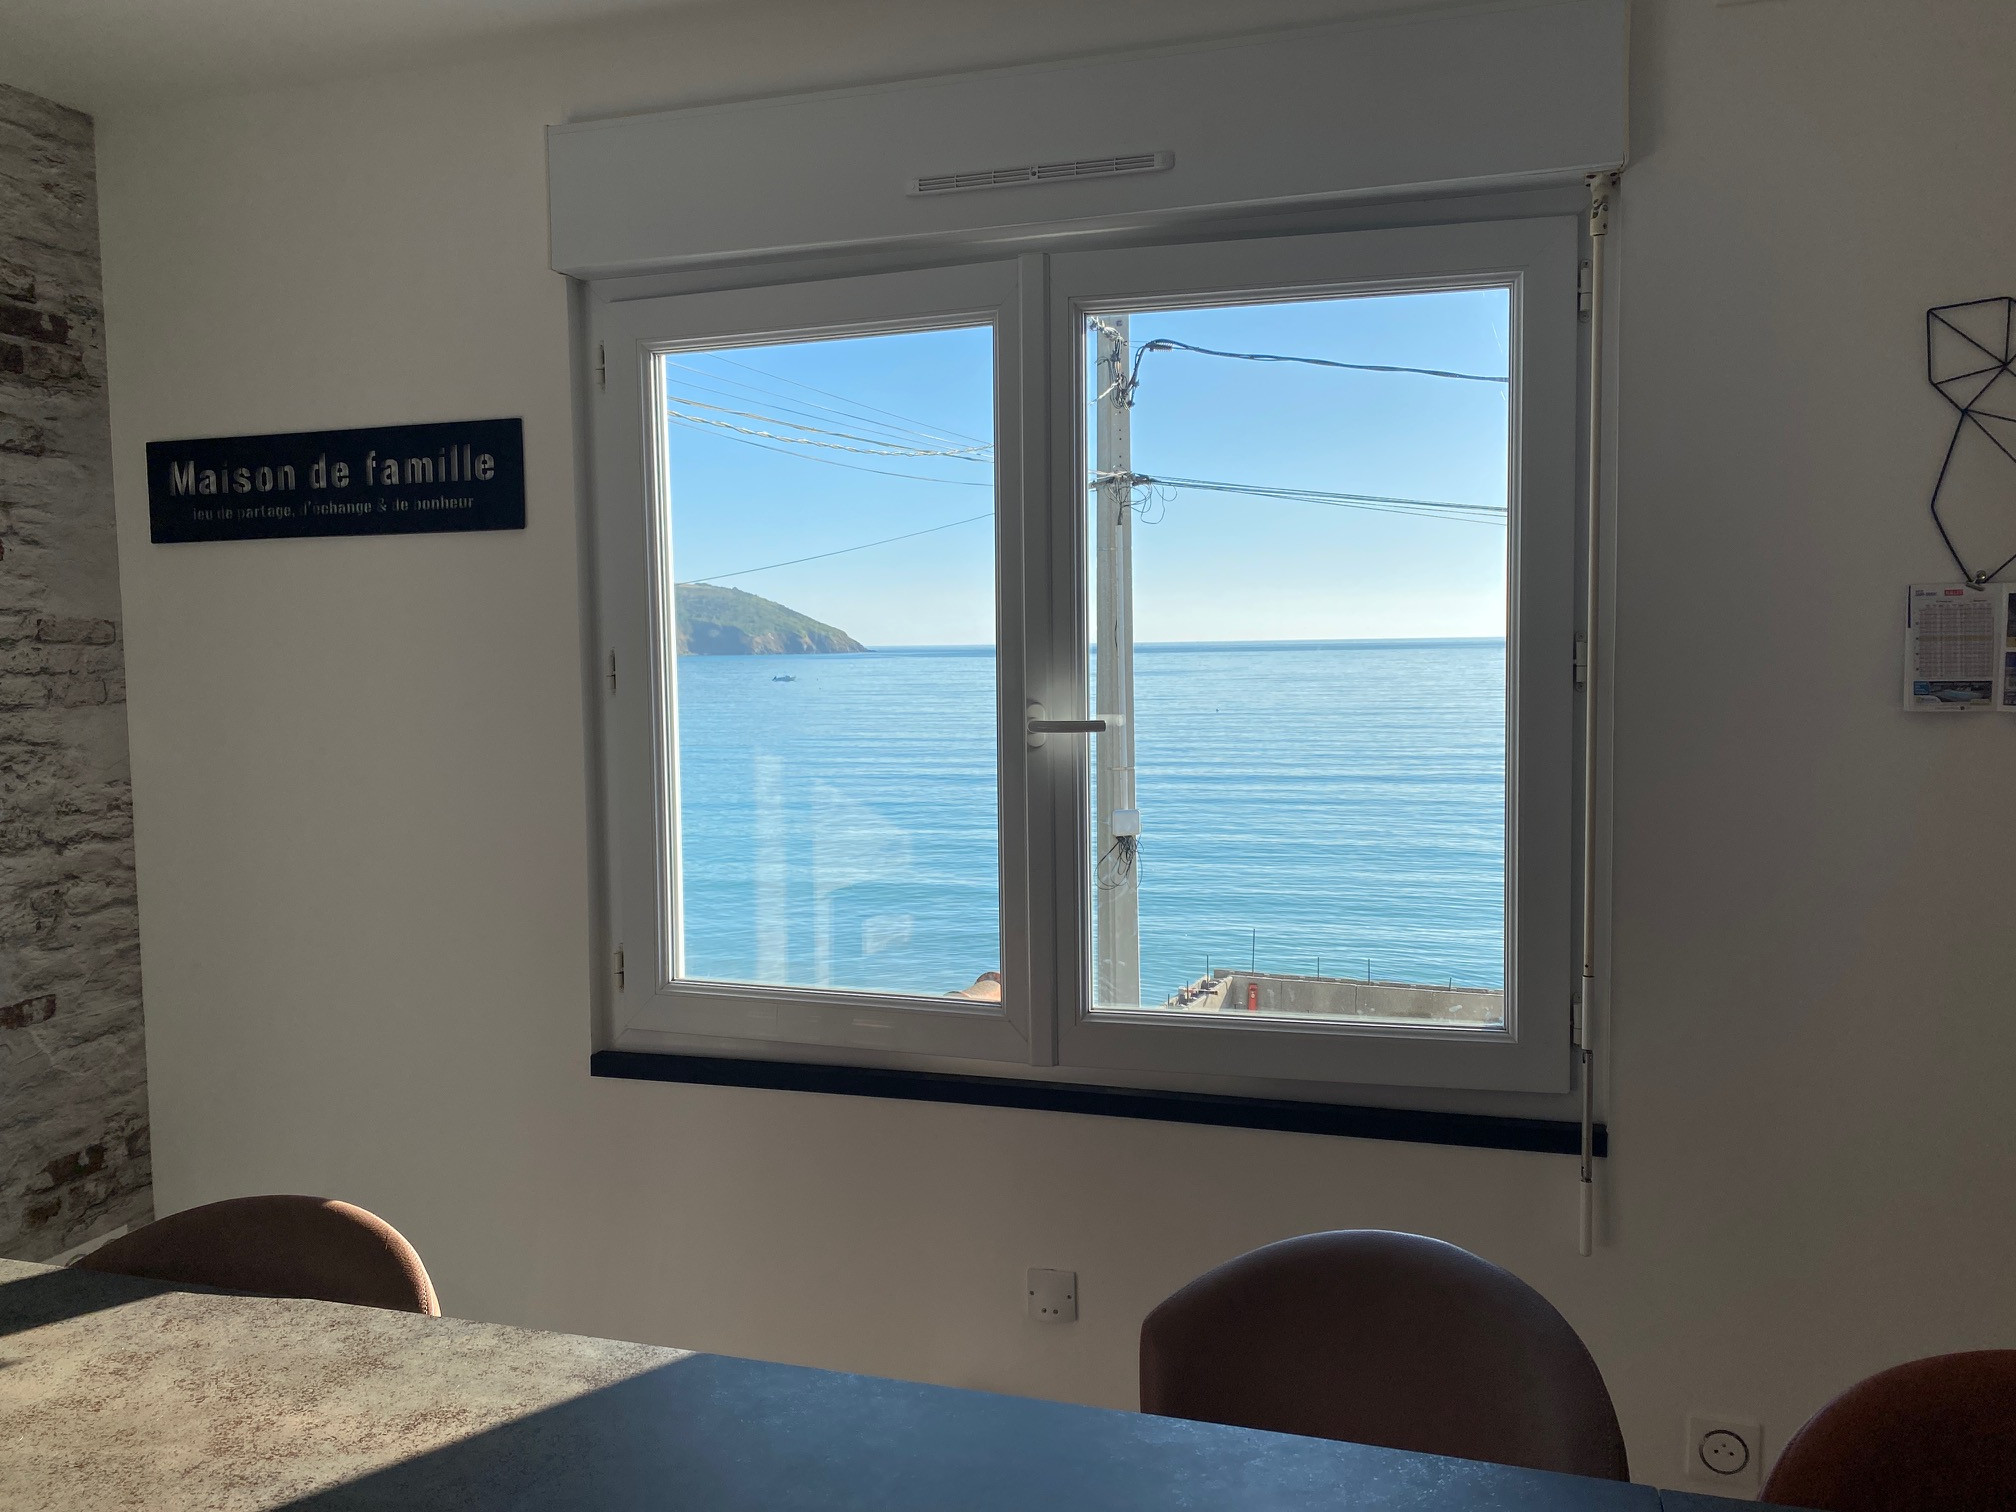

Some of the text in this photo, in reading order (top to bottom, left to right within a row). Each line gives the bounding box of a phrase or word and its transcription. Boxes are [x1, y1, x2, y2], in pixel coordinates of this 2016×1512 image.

[168, 443, 495, 497] Maison de famille
[217, 505, 233, 520] de
[237, 504, 296, 522] partage,
[376, 497, 388, 513] &
[392, 497, 409, 512] de
